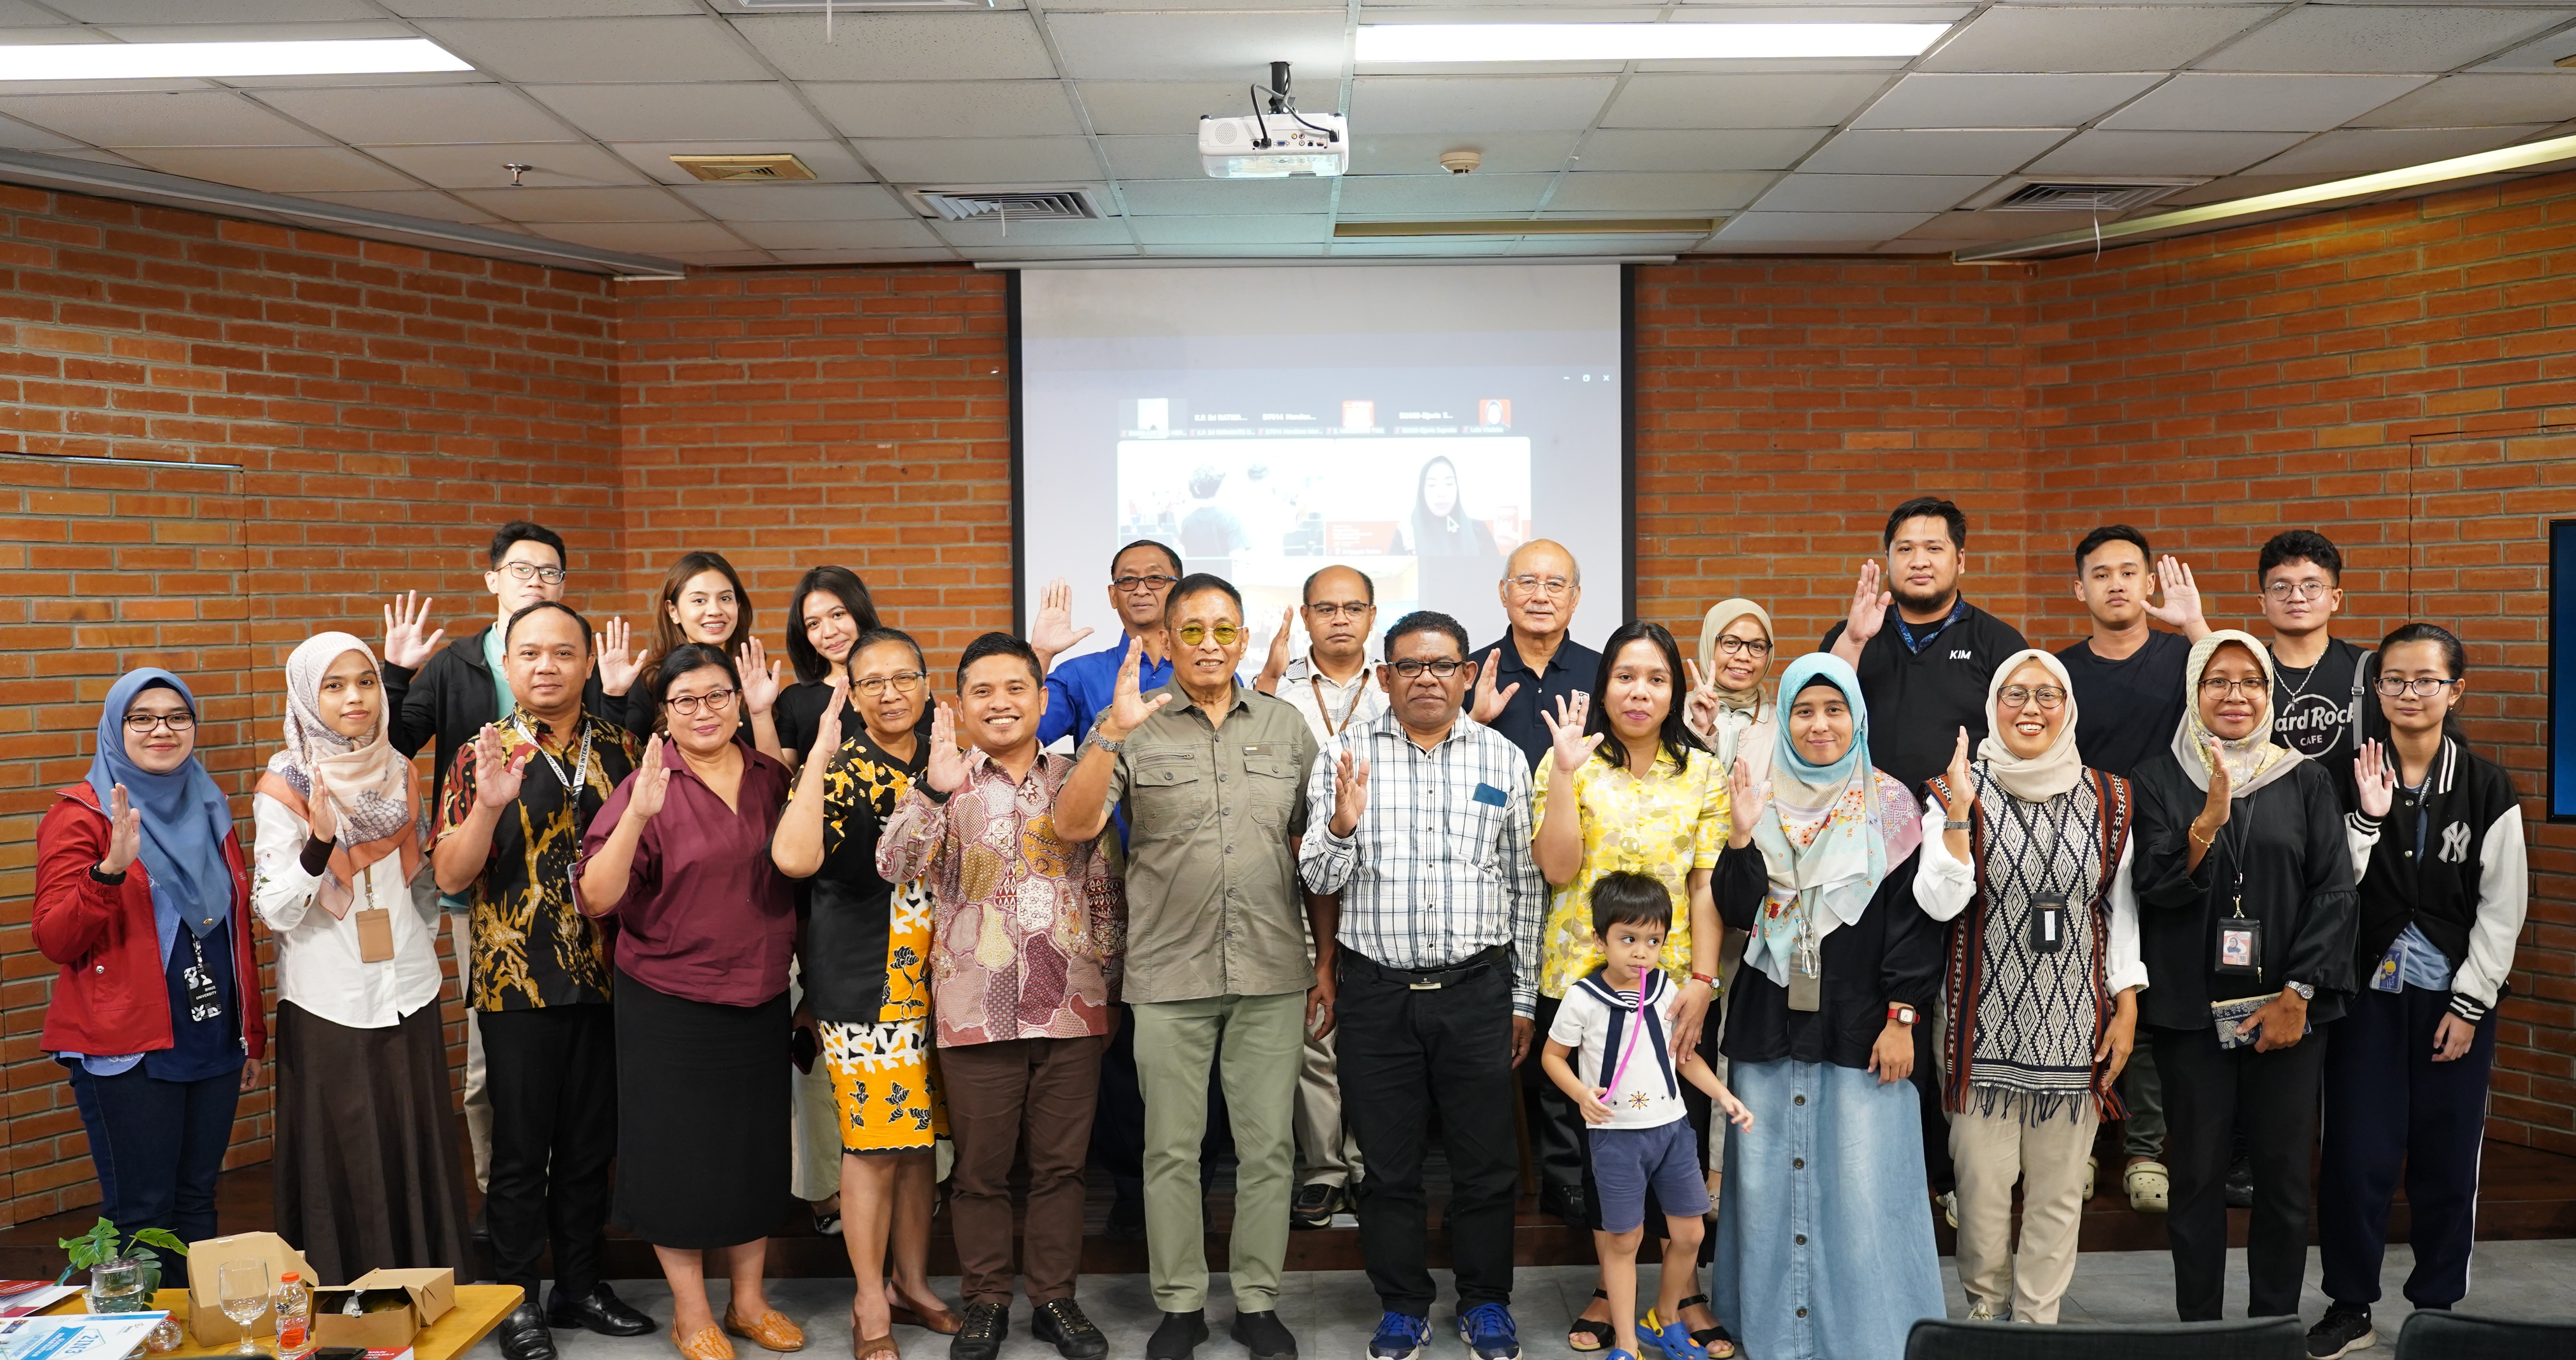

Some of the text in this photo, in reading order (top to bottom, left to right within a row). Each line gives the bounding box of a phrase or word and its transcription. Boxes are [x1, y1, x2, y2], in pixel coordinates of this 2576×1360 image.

[1949, 650, 1972, 660] KIM
[2274, 709, 2309, 732] ard
[2300, 735, 2323, 746] CAFE
[554, 766, 566, 783] BINUS
[576, 764, 585, 782] BINUS
[2418, 776, 2432, 805] UNIVERSITY
[2437, 820, 2472, 864] NY
[196, 991, 217, 1000] UNIVERSITY
